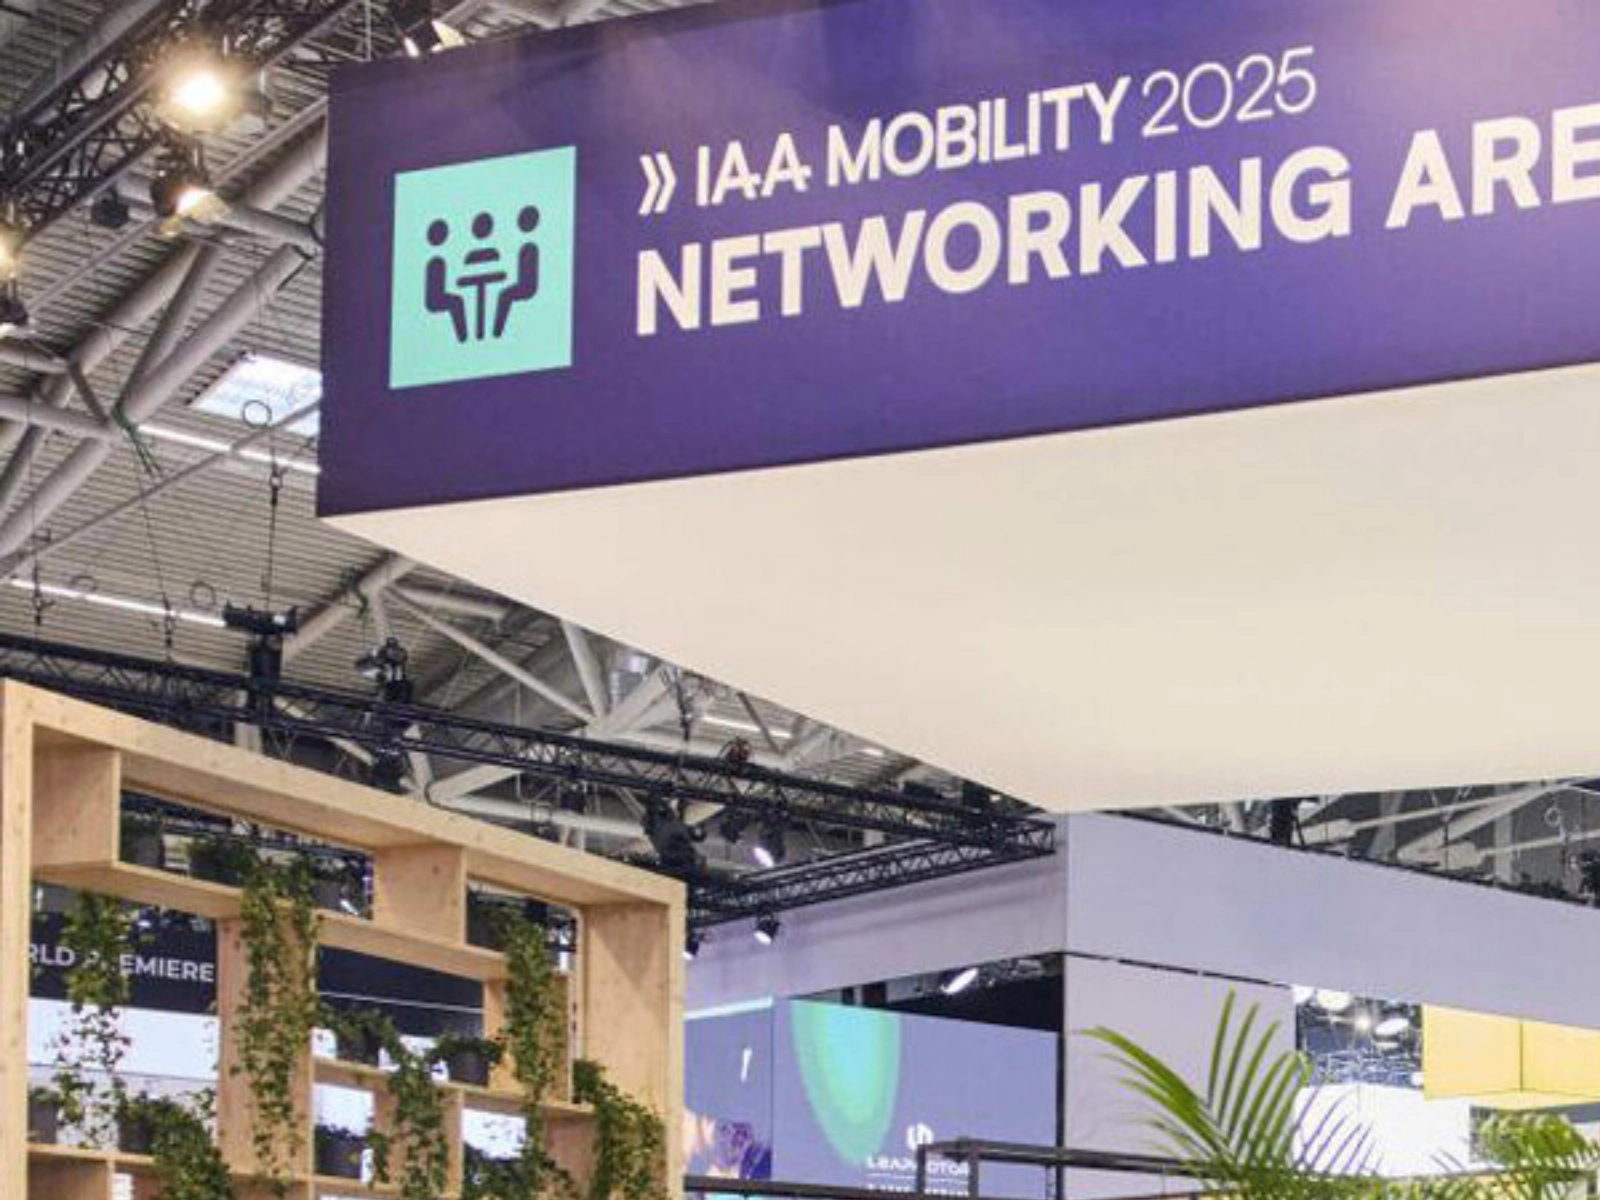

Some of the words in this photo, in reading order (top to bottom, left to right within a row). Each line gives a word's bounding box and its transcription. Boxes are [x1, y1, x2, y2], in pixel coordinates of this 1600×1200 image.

[697, 132, 812, 207] IAA
[827, 76, 1132, 188] MOBILITY
[1141, 45, 1317, 137] 2025
[635, 145, 1353, 337] NETWORKING
[28, 943, 76, 967] RLD
